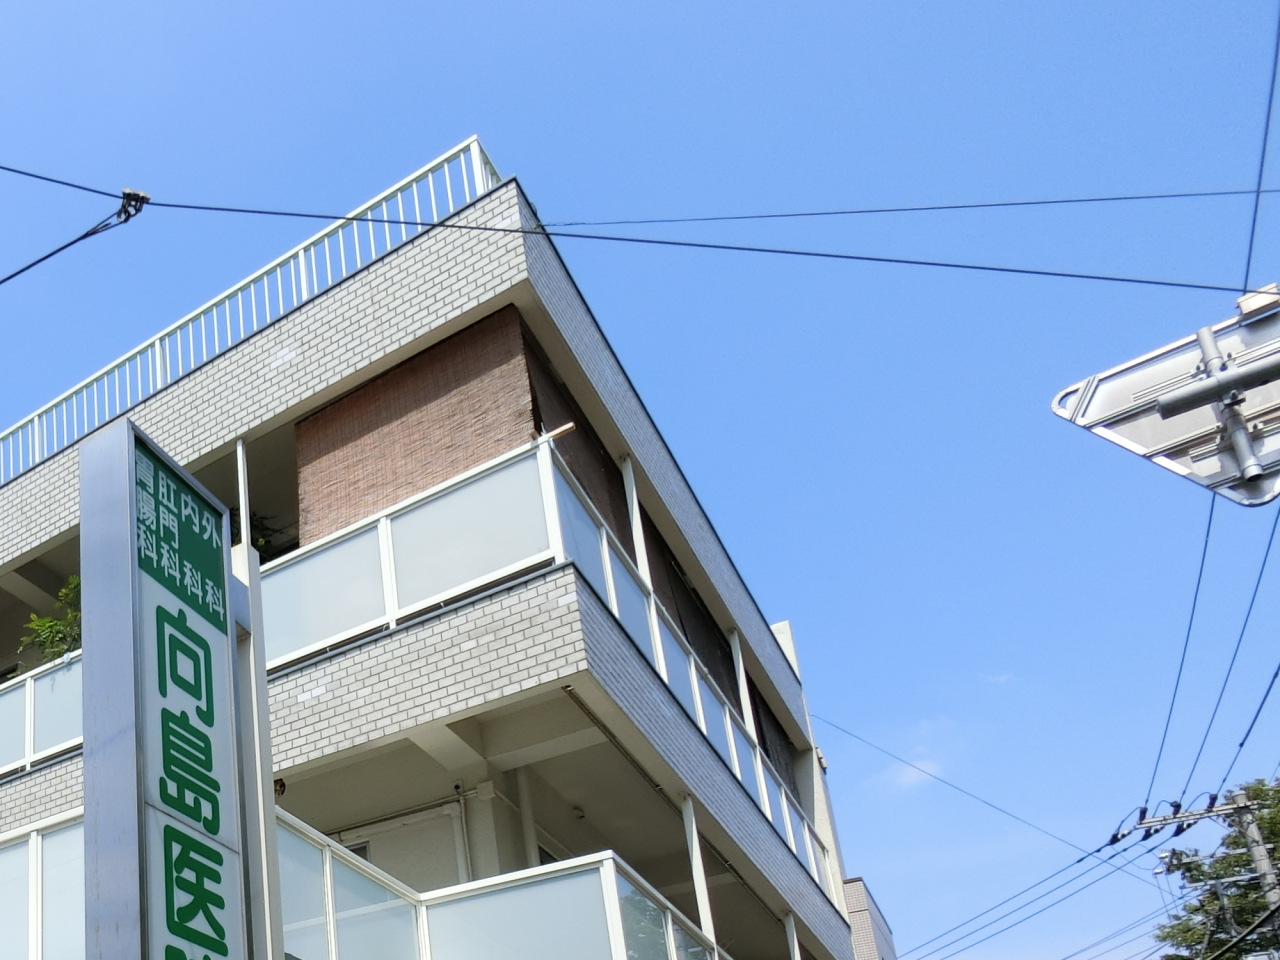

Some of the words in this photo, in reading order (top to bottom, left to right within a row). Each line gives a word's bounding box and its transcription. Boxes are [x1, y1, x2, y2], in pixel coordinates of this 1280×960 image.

[135, 452, 158, 570] 胃腸科
[158, 469, 181, 588] 肛門科
[180, 493, 204, 606] 内科
[201, 514, 224, 622] 外科
